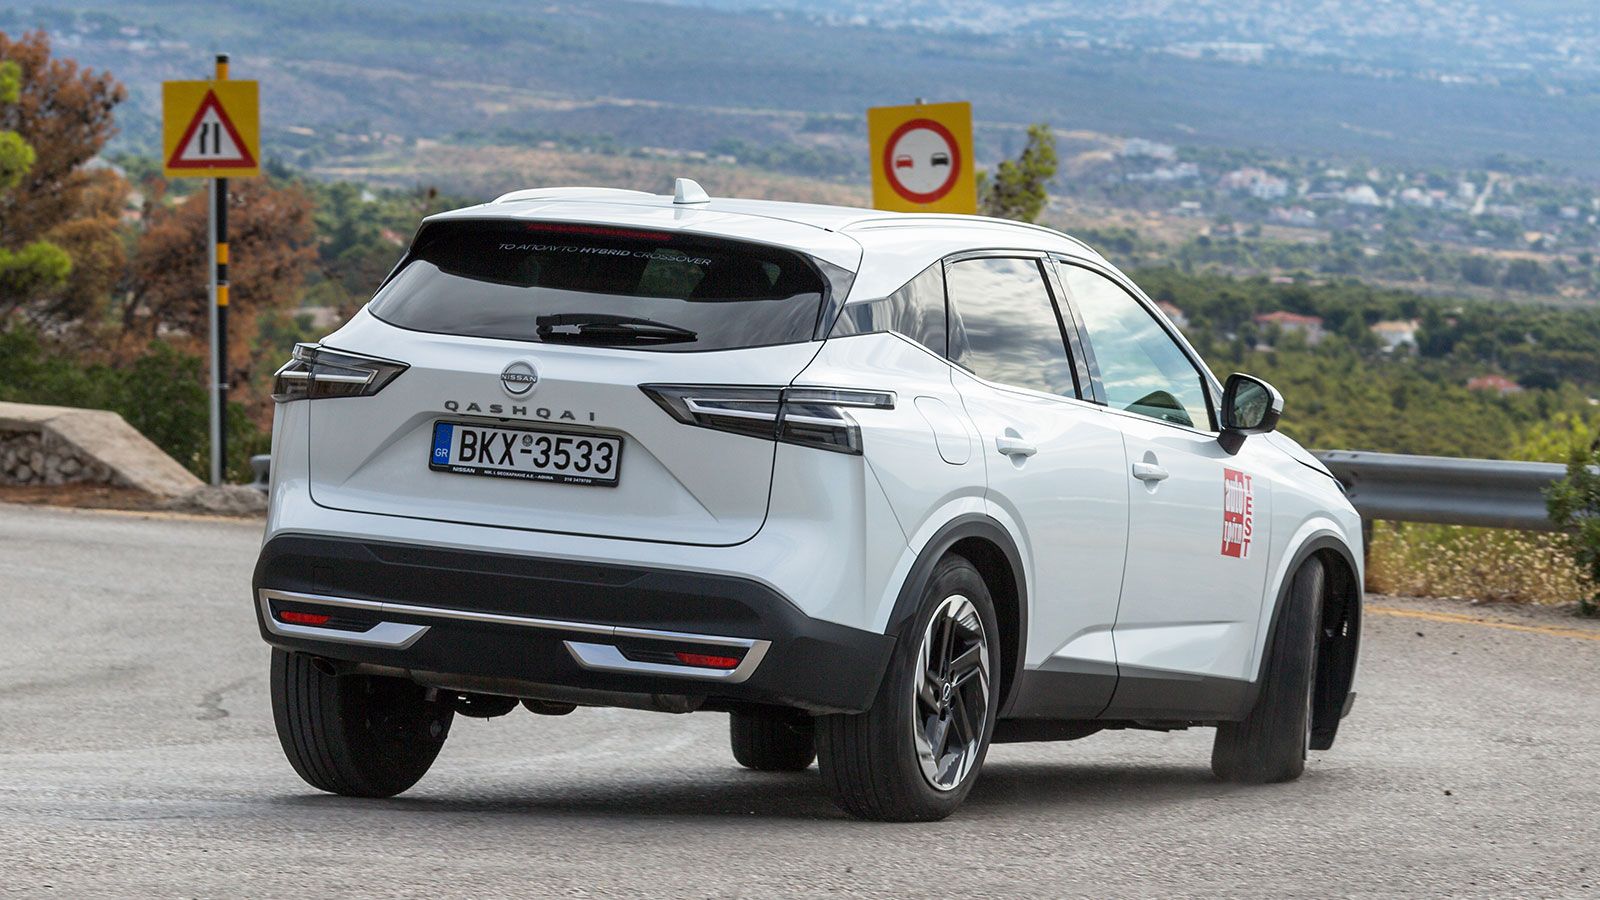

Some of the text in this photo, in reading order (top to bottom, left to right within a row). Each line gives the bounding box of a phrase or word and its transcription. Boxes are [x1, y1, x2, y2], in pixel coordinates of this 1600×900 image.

[580, 247, 630, 256] HYBRID
[633, 251, 712, 265] CROSSOVER
[501, 373, 537, 383] NISSAN
[444, 400, 595, 421] QASHQAI
[435, 448, 449, 457] GR
[452, 466, 476, 474] NISSAN
[1225, 474, 1243, 514] auto
[1244, 475, 1252, 557] TEST
